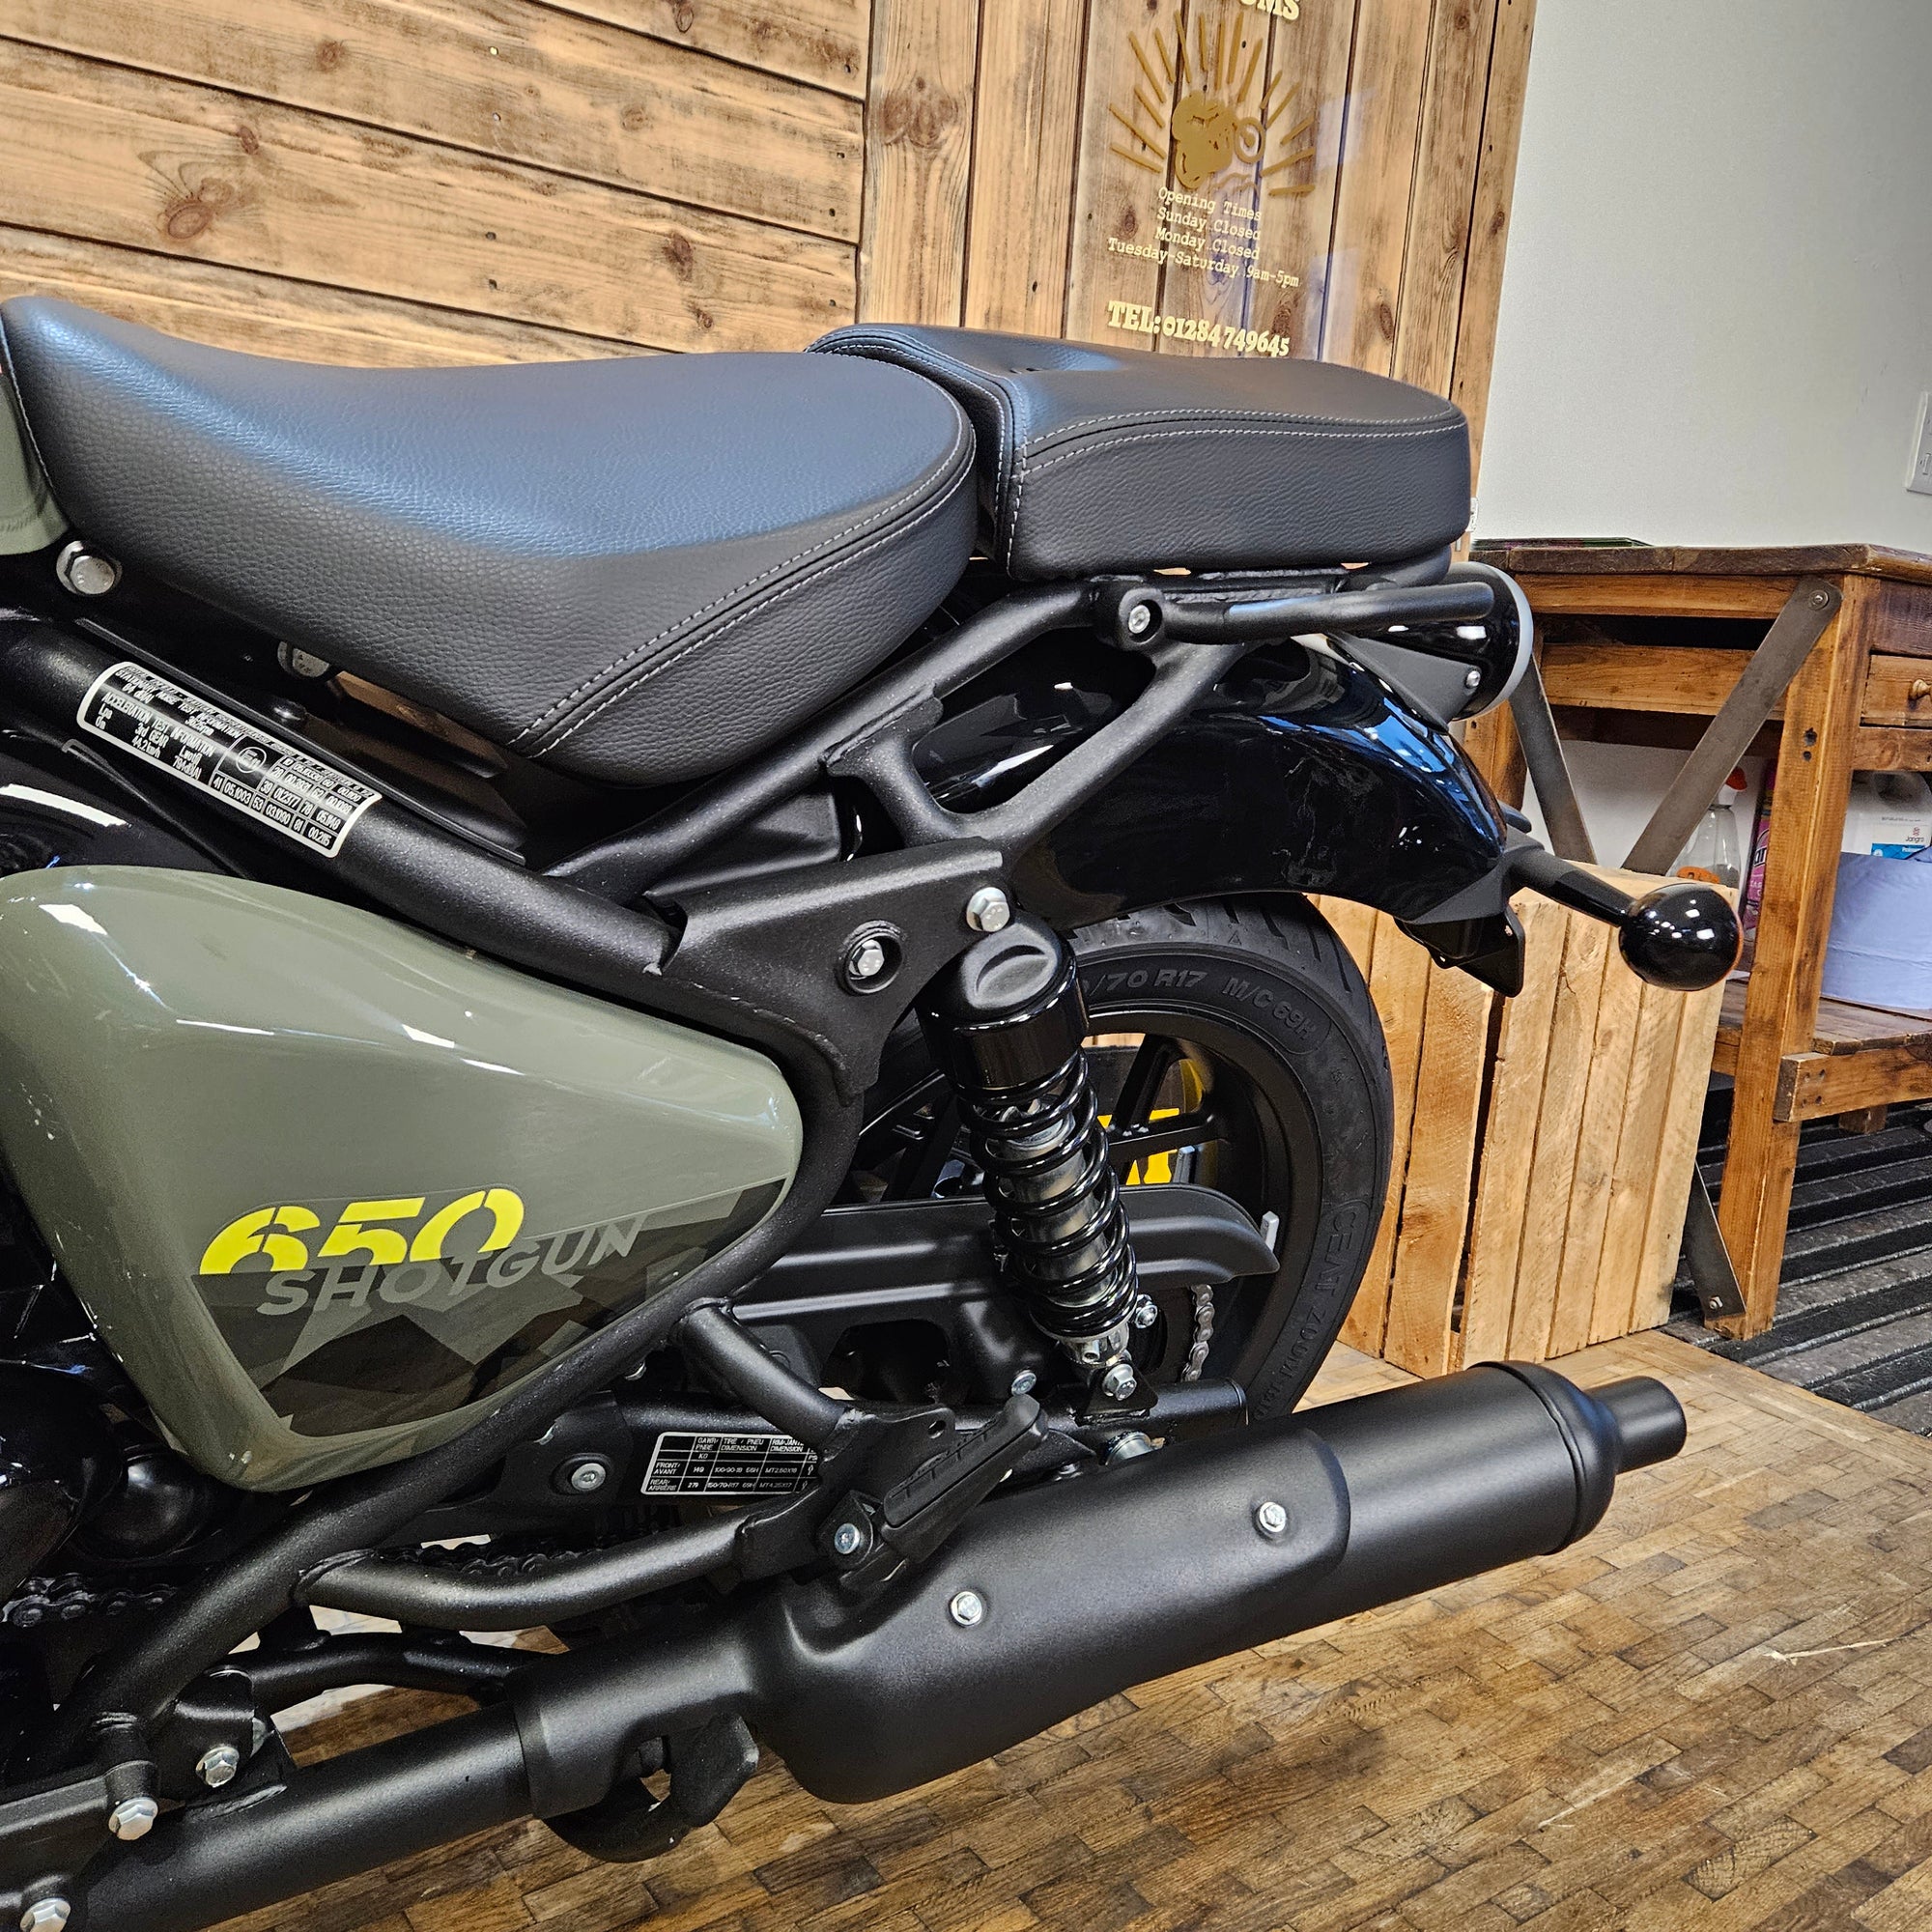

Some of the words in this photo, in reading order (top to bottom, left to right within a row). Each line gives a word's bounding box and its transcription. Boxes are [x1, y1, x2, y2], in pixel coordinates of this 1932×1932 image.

[1158, 186, 1216, 214] Opening
[1223, 200, 1262, 221] Times
[1157, 207, 1208, 232] Sunday
[1213, 219, 1262, 241] Closed
[1154, 227, 1206, 251] Monday
[1212, 239, 1260, 260] Closed
[1108, 238, 1239, 278] Tuesday-Saturday
[1246, 265, 1300, 288] 9am-5pm
[100, 691, 153, 724] ACCELERATION
[151, 717, 172, 734] TEST
[169, 726, 216, 757] INFORMATION
[147, 728, 170, 748] GEAR
[177, 701, 199, 716] TEST
[195, 711, 242, 739] INFORMATION
[211, 775, 223, 789] 41
[222, 781, 252, 804] 05.1003
[251, 796, 264, 810] 53
[1153, 969, 1208, 990] R17
[1221, 977, 1274, 1009] M/C
[199, 1187, 525, 1275] 650
[256, 1214, 647, 1316] SHOTGUN
